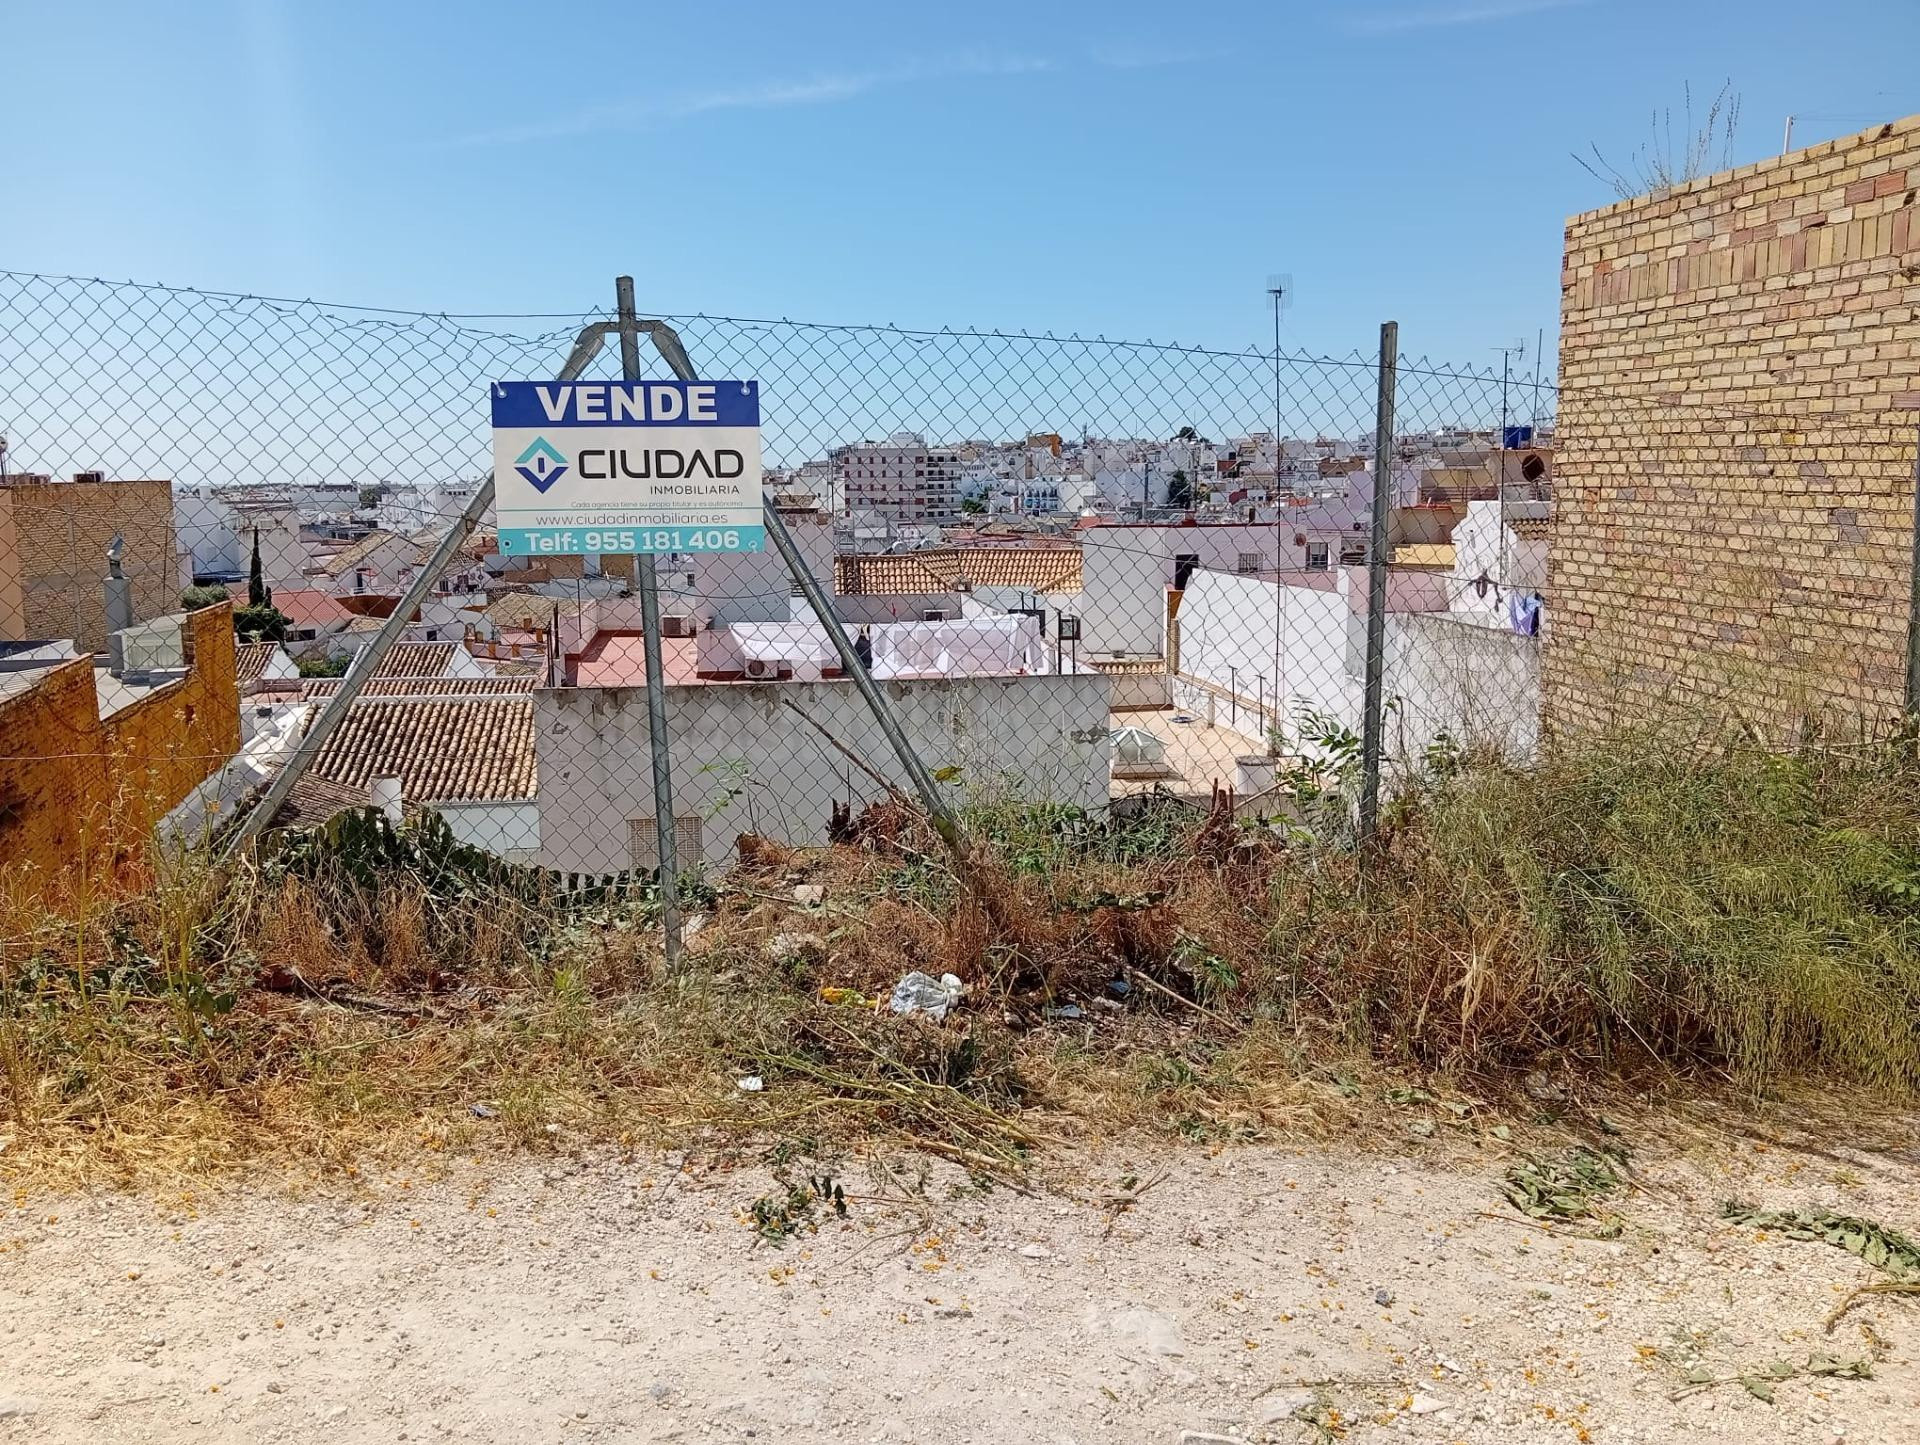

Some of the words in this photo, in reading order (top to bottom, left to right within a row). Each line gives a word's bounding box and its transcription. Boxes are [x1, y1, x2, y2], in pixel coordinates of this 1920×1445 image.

[536, 386, 718, 421] VENDE
[578, 449, 744, 479] CIUDAD
[650, 485, 740, 495] INMOBILIARIA
[536, 513, 728, 526] www.ciudadinmobiliaria.es
[525, 533, 578, 551] Telf:
[585, 531, 635, 550] 955
[643, 531, 682, 550] 181
[689, 530, 740, 549] 406
